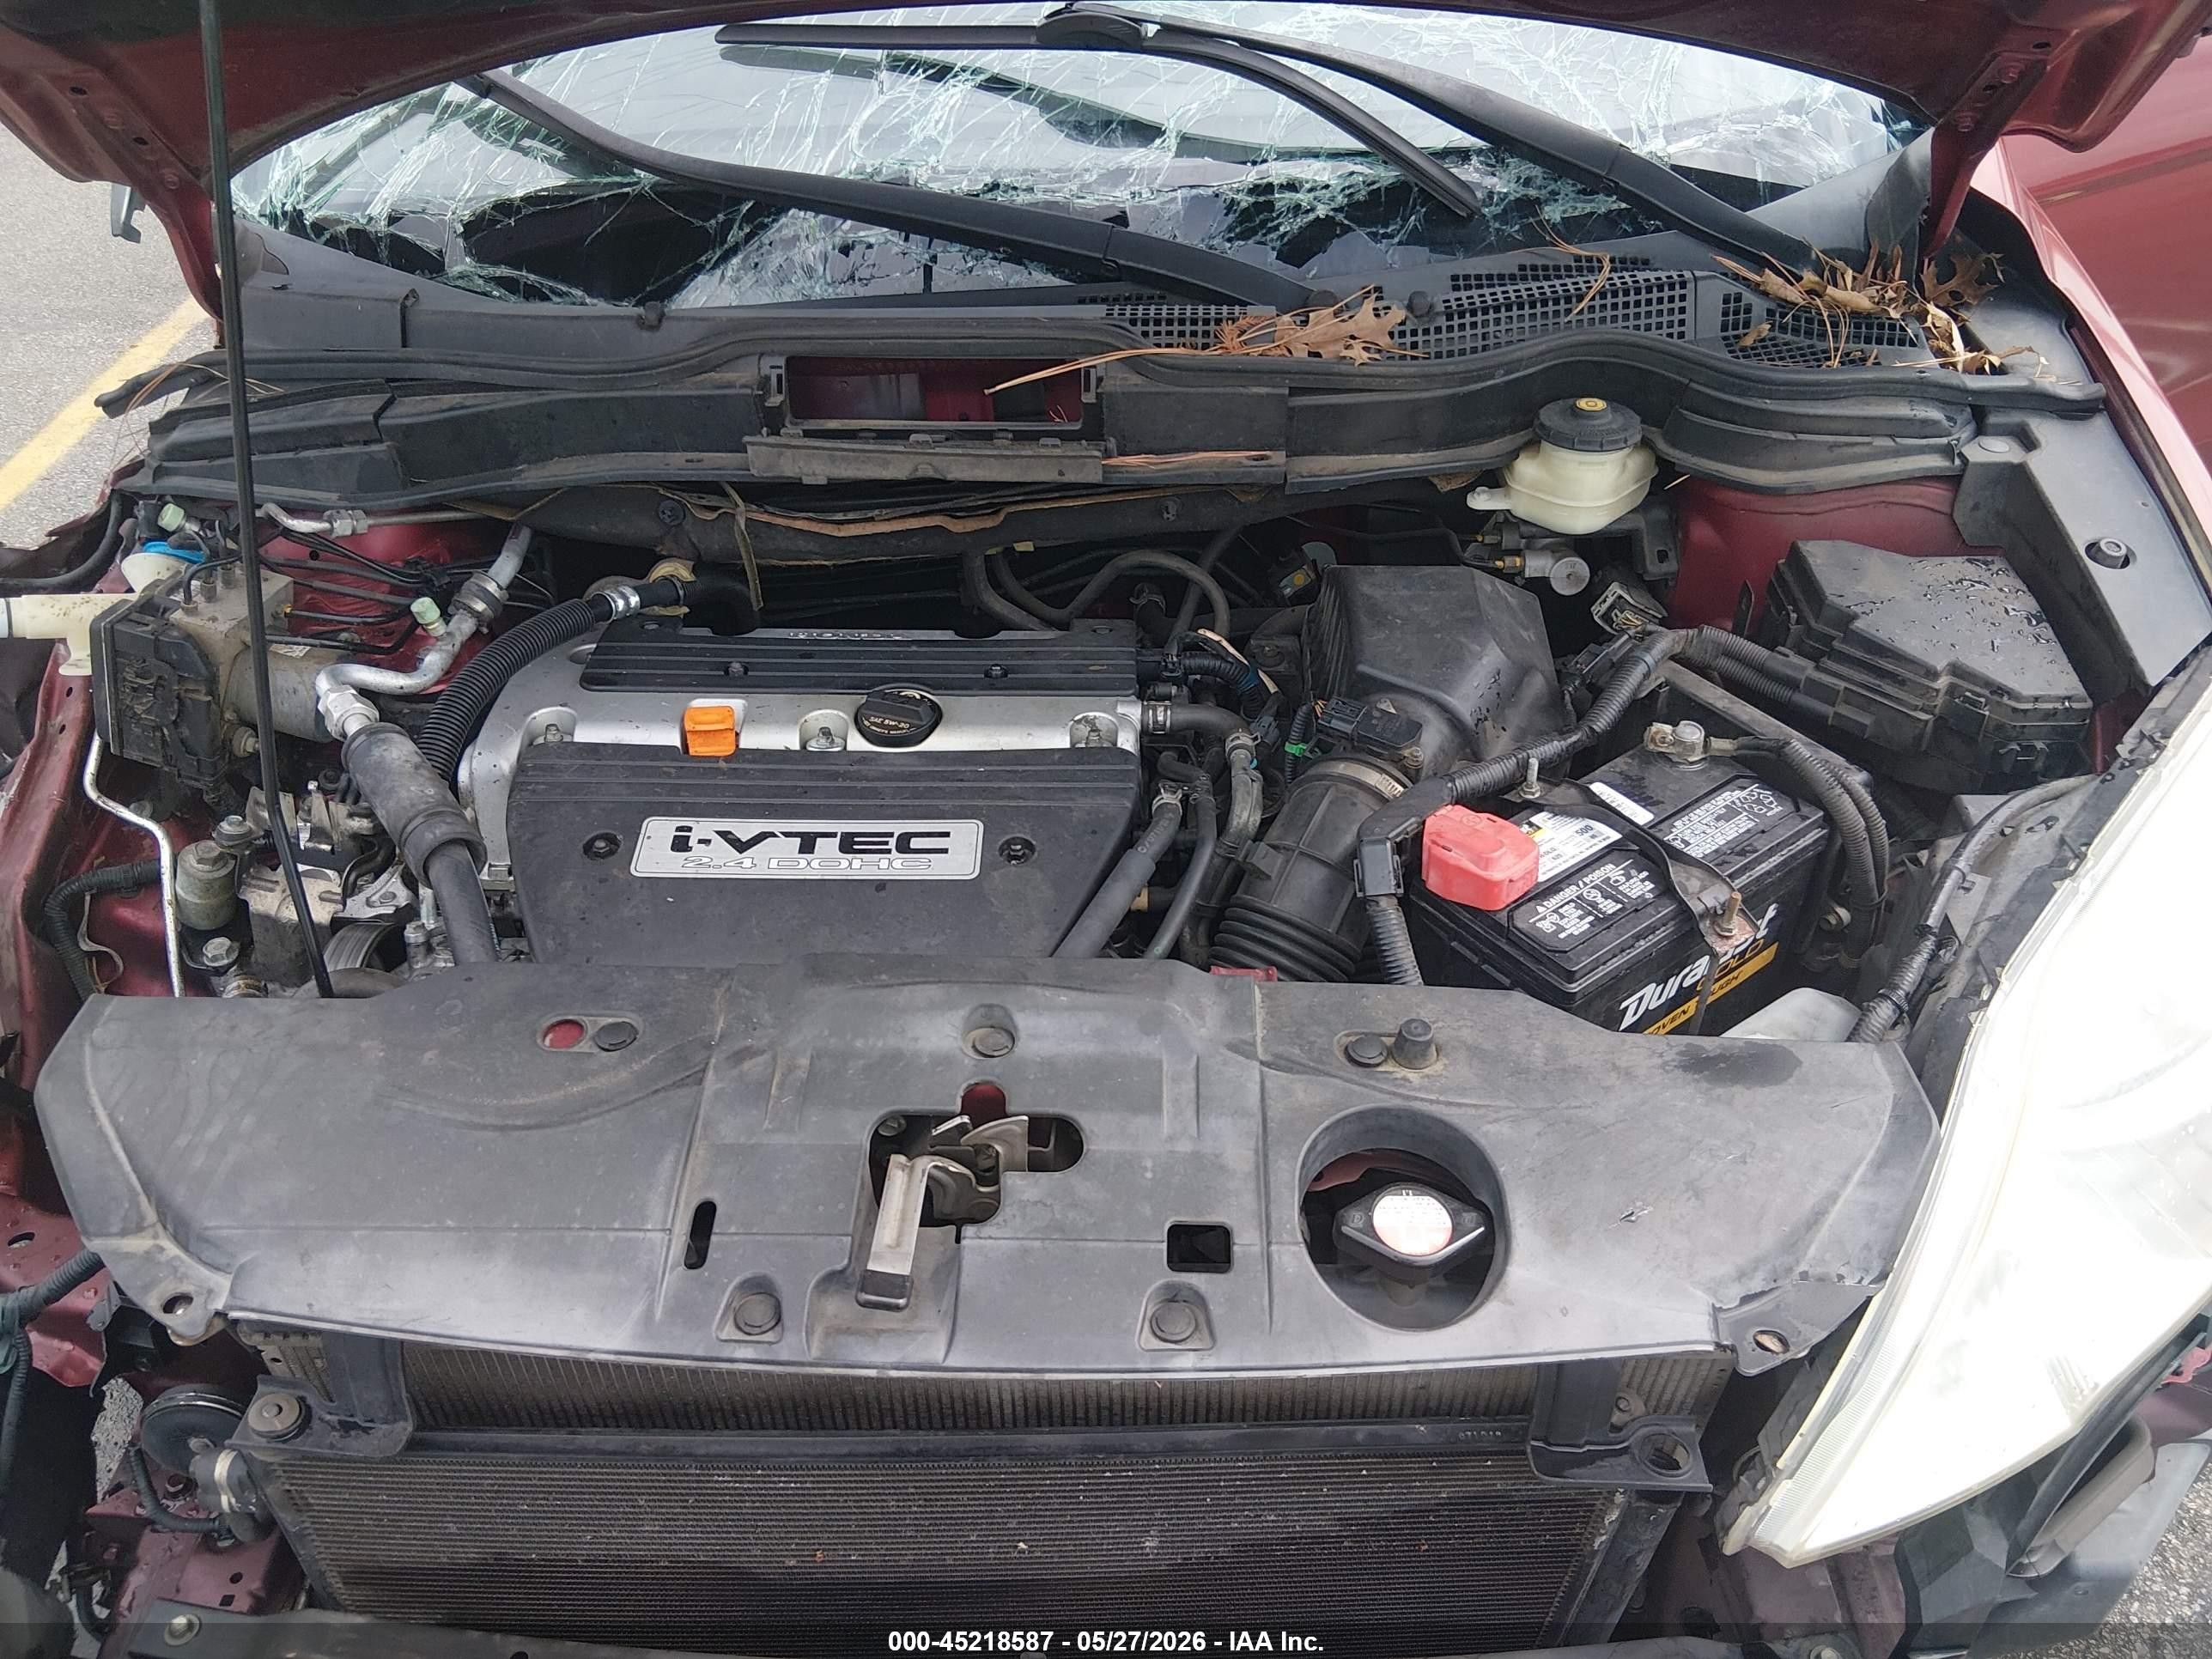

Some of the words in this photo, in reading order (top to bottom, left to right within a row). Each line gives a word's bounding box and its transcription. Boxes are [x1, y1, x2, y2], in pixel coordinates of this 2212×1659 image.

[884, 719, 910, 729] 5W-20
[1575, 824, 1594, 836] 500
[670, 825, 951, 855] i-VTEC
[682, 857, 757, 869] 2.4
[768, 858, 933, 871] DOHC
[1543, 884, 1580, 908] DANGER
[1583, 863, 1617, 884] POISON
